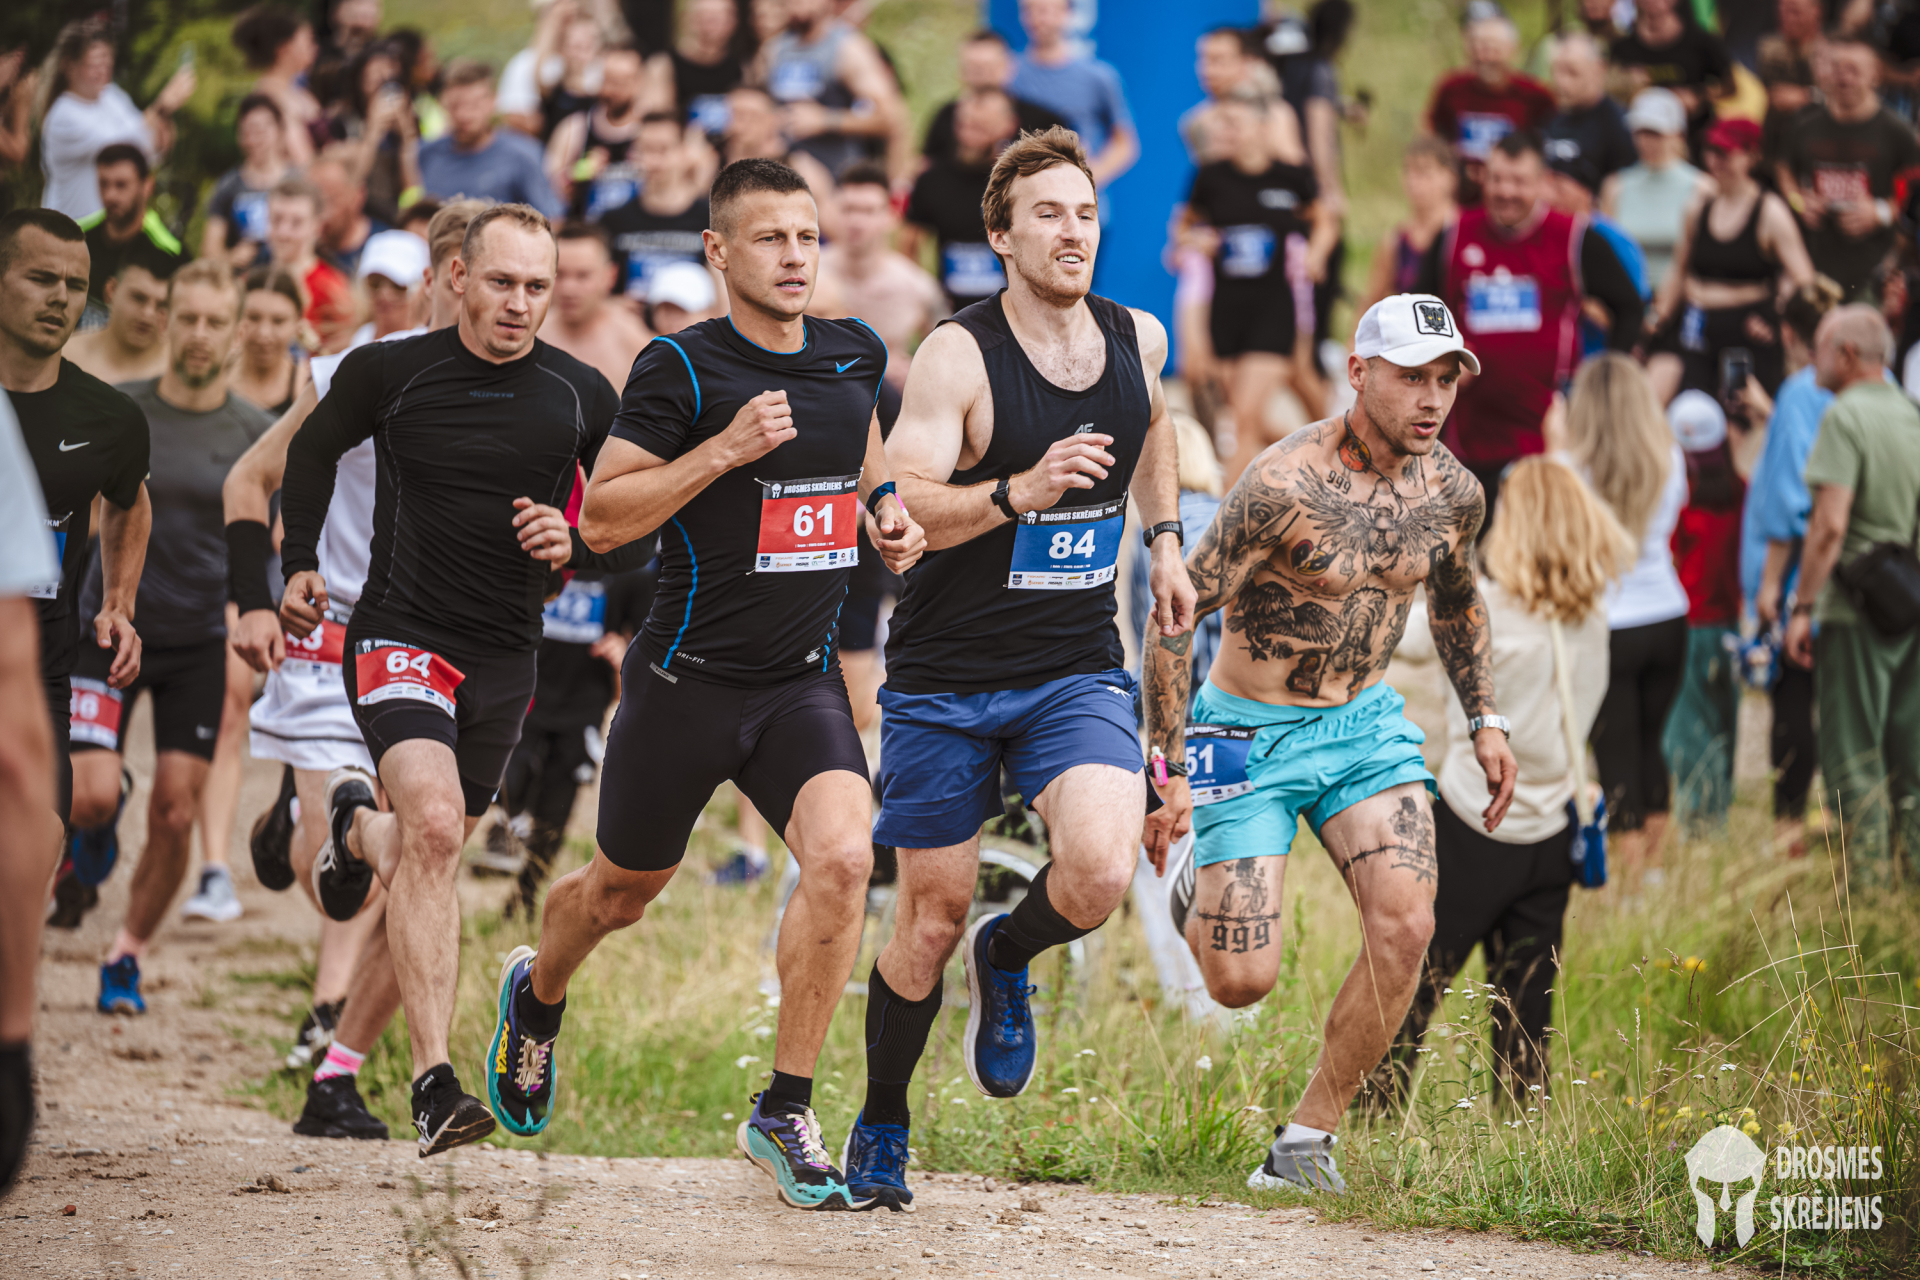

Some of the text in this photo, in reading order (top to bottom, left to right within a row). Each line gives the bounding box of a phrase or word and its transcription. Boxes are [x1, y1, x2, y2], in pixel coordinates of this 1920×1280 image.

[784, 483, 811, 494] DROSMES
[793, 503, 833, 537] 61
[1040, 512, 1072, 522] DROSMES
[1104, 505, 1117, 515] 7KM
[1048, 529, 1096, 559] 84
[386, 651, 433, 679] 64
[676, 651, 706, 664] DRI-FIT
[1230, 730, 1248, 738] 7KM
[1185, 744, 1214, 777] 51
[1210, 922, 1270, 954] 999
